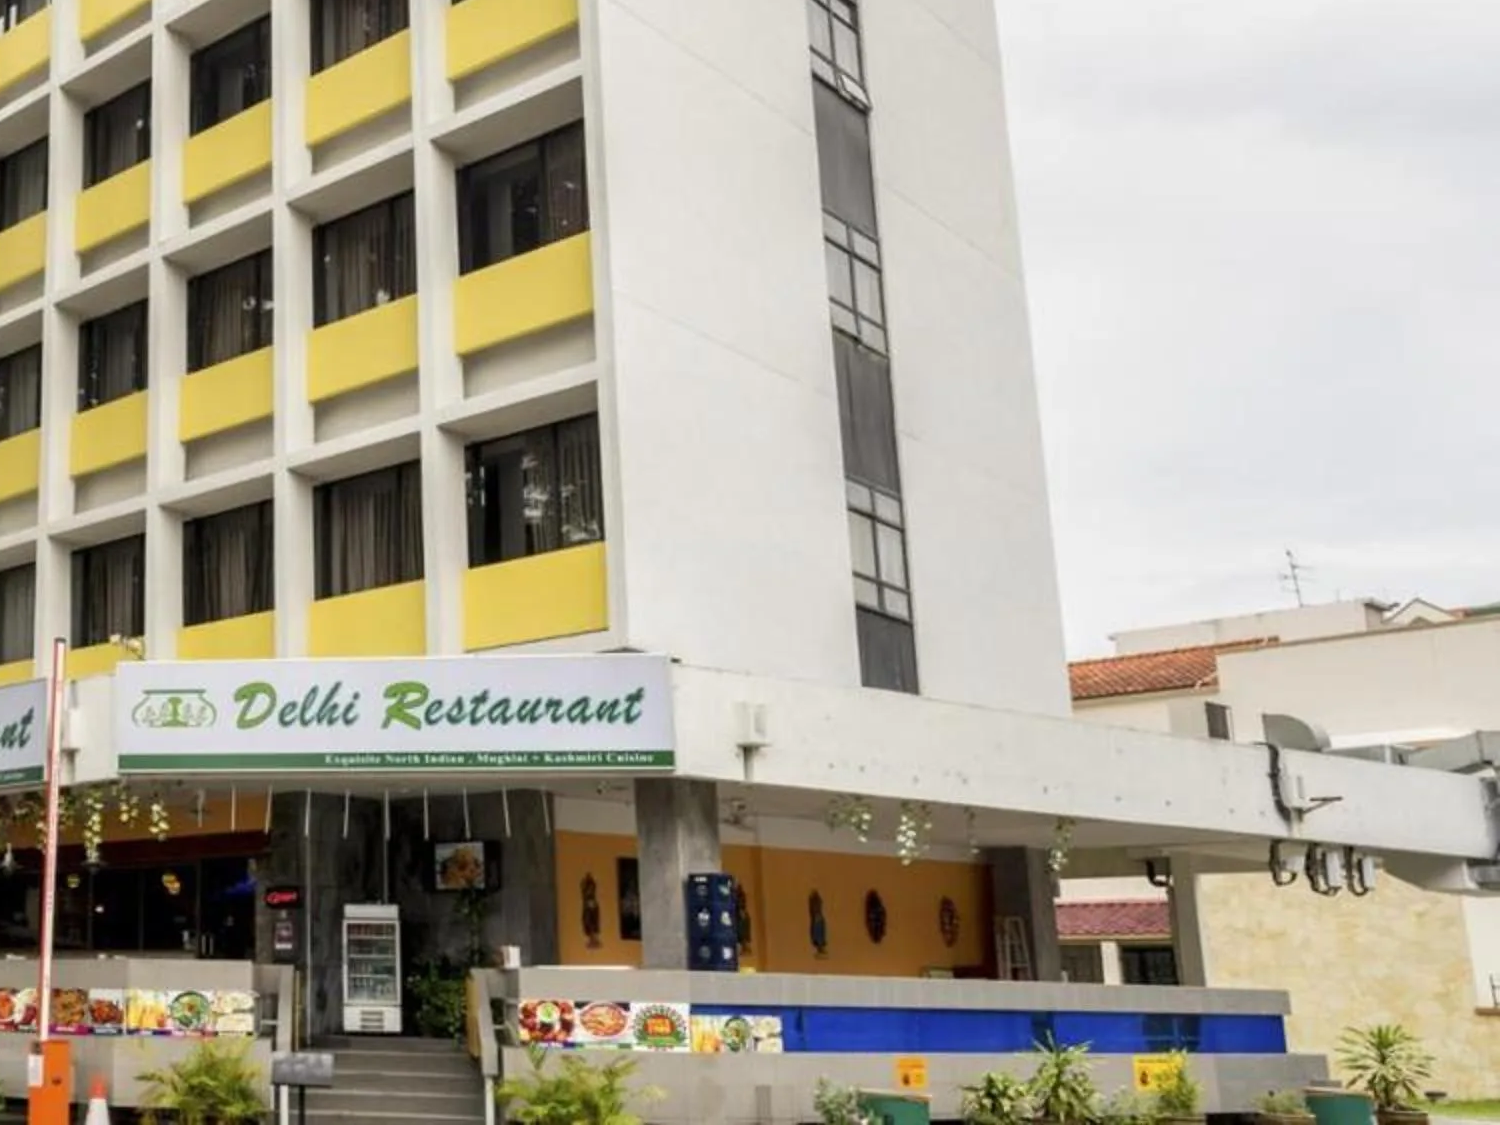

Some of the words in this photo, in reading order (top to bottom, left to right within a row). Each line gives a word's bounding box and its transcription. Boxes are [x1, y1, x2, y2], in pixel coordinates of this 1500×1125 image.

[233, 680, 361, 732] Delhi
[381, 680, 645, 732] Restaurant
[385, 753, 420, 764] North
[425, 753, 465, 764] Indian
